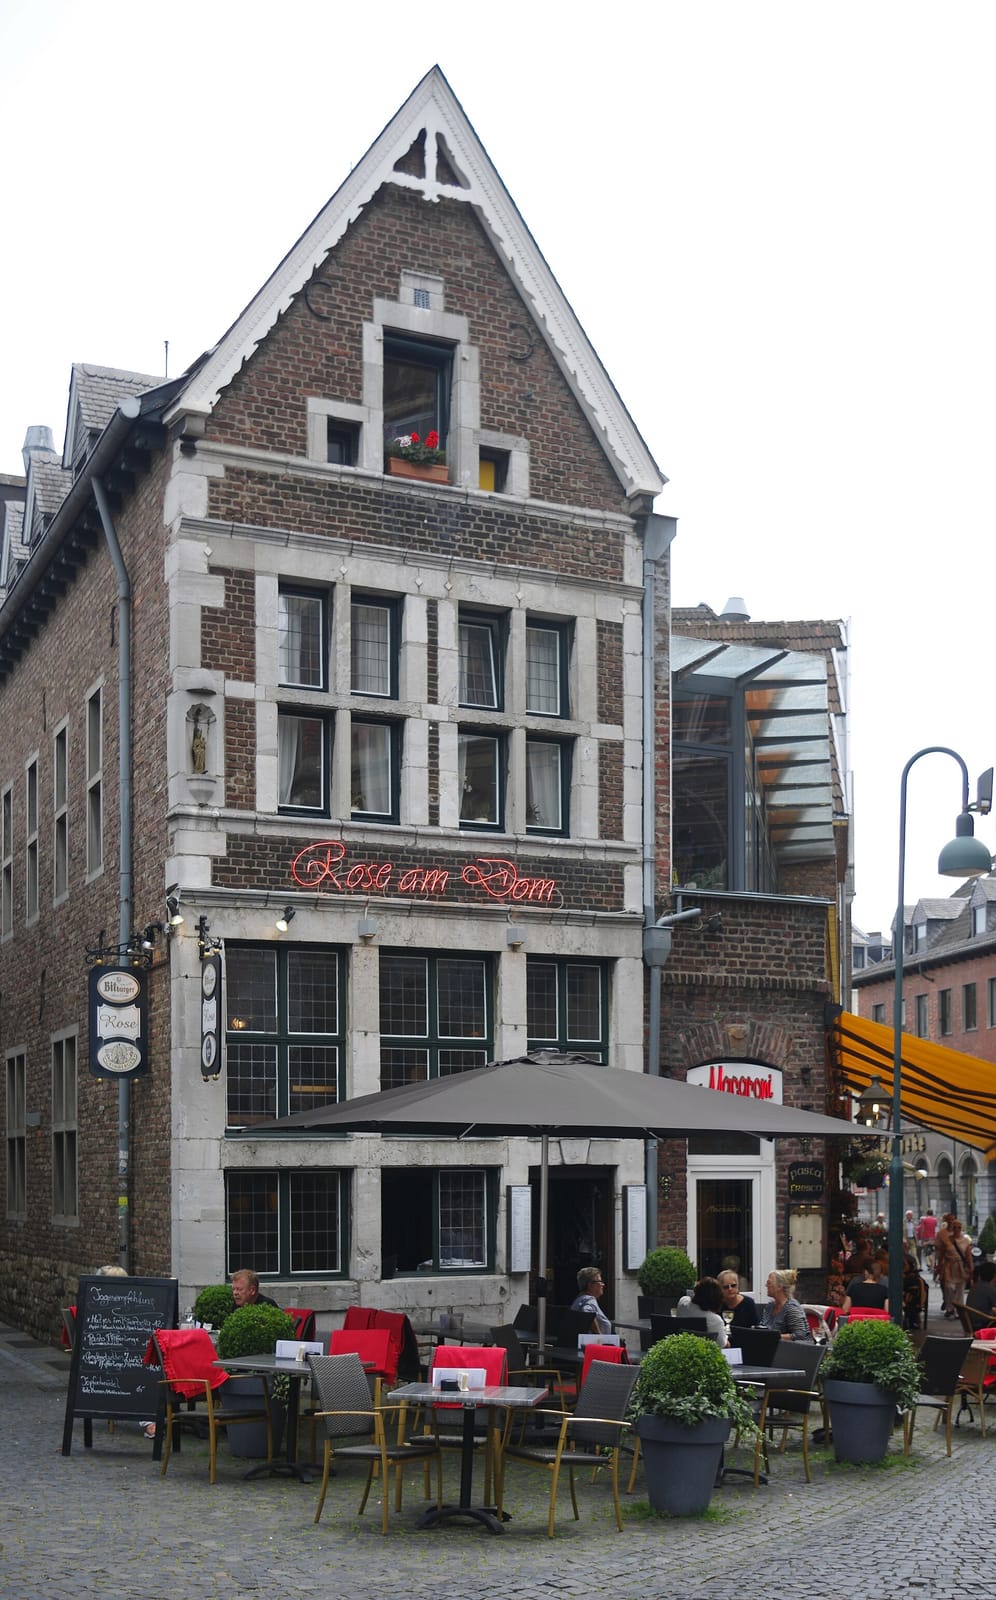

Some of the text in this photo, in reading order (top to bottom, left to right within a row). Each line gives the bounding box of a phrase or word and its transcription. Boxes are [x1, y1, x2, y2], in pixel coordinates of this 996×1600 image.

[291, 841, 557, 901] Rose am Dom
[103, 981, 135, 994] Bitburger
[99, 1014, 137, 1029] Rose
